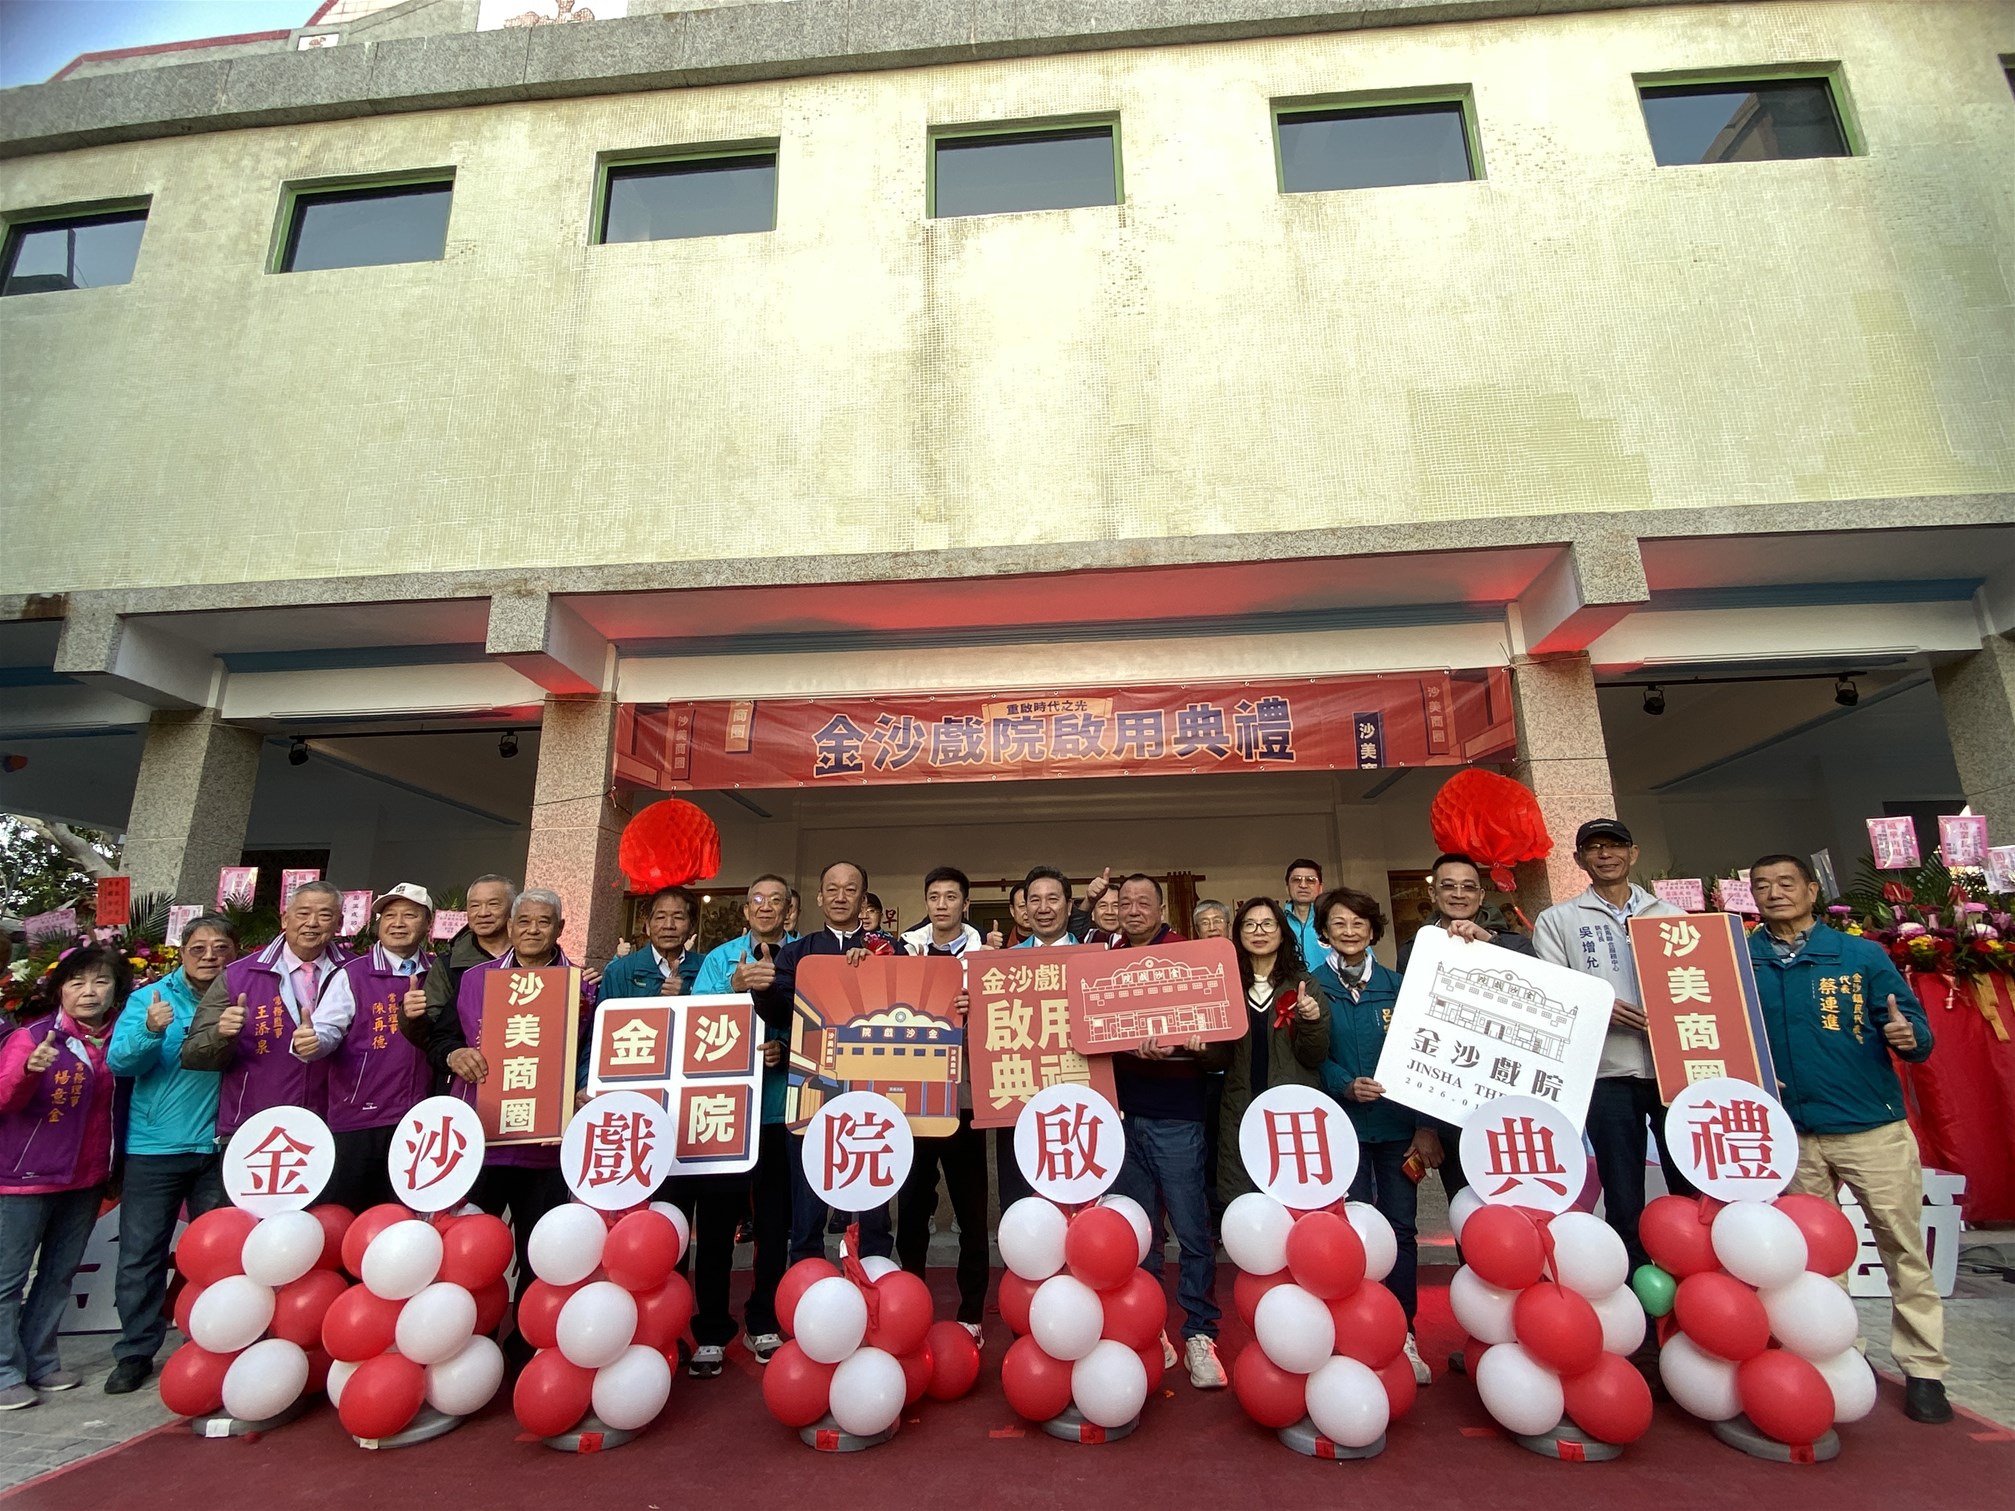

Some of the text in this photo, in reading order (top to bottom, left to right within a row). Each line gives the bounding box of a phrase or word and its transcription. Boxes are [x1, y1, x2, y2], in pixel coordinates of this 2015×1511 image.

[813, 696, 1296, 777] 金沙戲院啟用典禮
[1007, 700, 1088, 720] 重啟時代之光
[1427, 686, 1445, 743] 沙美商圈
[981, 964, 1067, 994] 金沙戲
[1579, 926, 1599, 970] 吳增允
[255, 1005, 271, 1055] 王添泉
[372, 1002, 388, 1050] 陳再德
[985, 999, 1071, 1051] 啟用
[1818, 977, 1841, 1031] 蔡連進
[499, 972, 545, 1135] 沙美商圈
[1406, 1059, 1463, 1089] JINSHA
[1411, 1027, 1564, 1103] 金沙戲院
[240, 1127, 315, 1196] 金
[404, 1116, 467, 1190] 沙
[577, 1111, 653, 1189] 戲
[823, 1112, 895, 1191] 院
[1035, 1103, 1109, 1183] 啟
[1263, 1107, 1333, 1187] 用
[1484, 1117, 1567, 1198] 典
[1687, 1099, 1782, 1181] 禮
